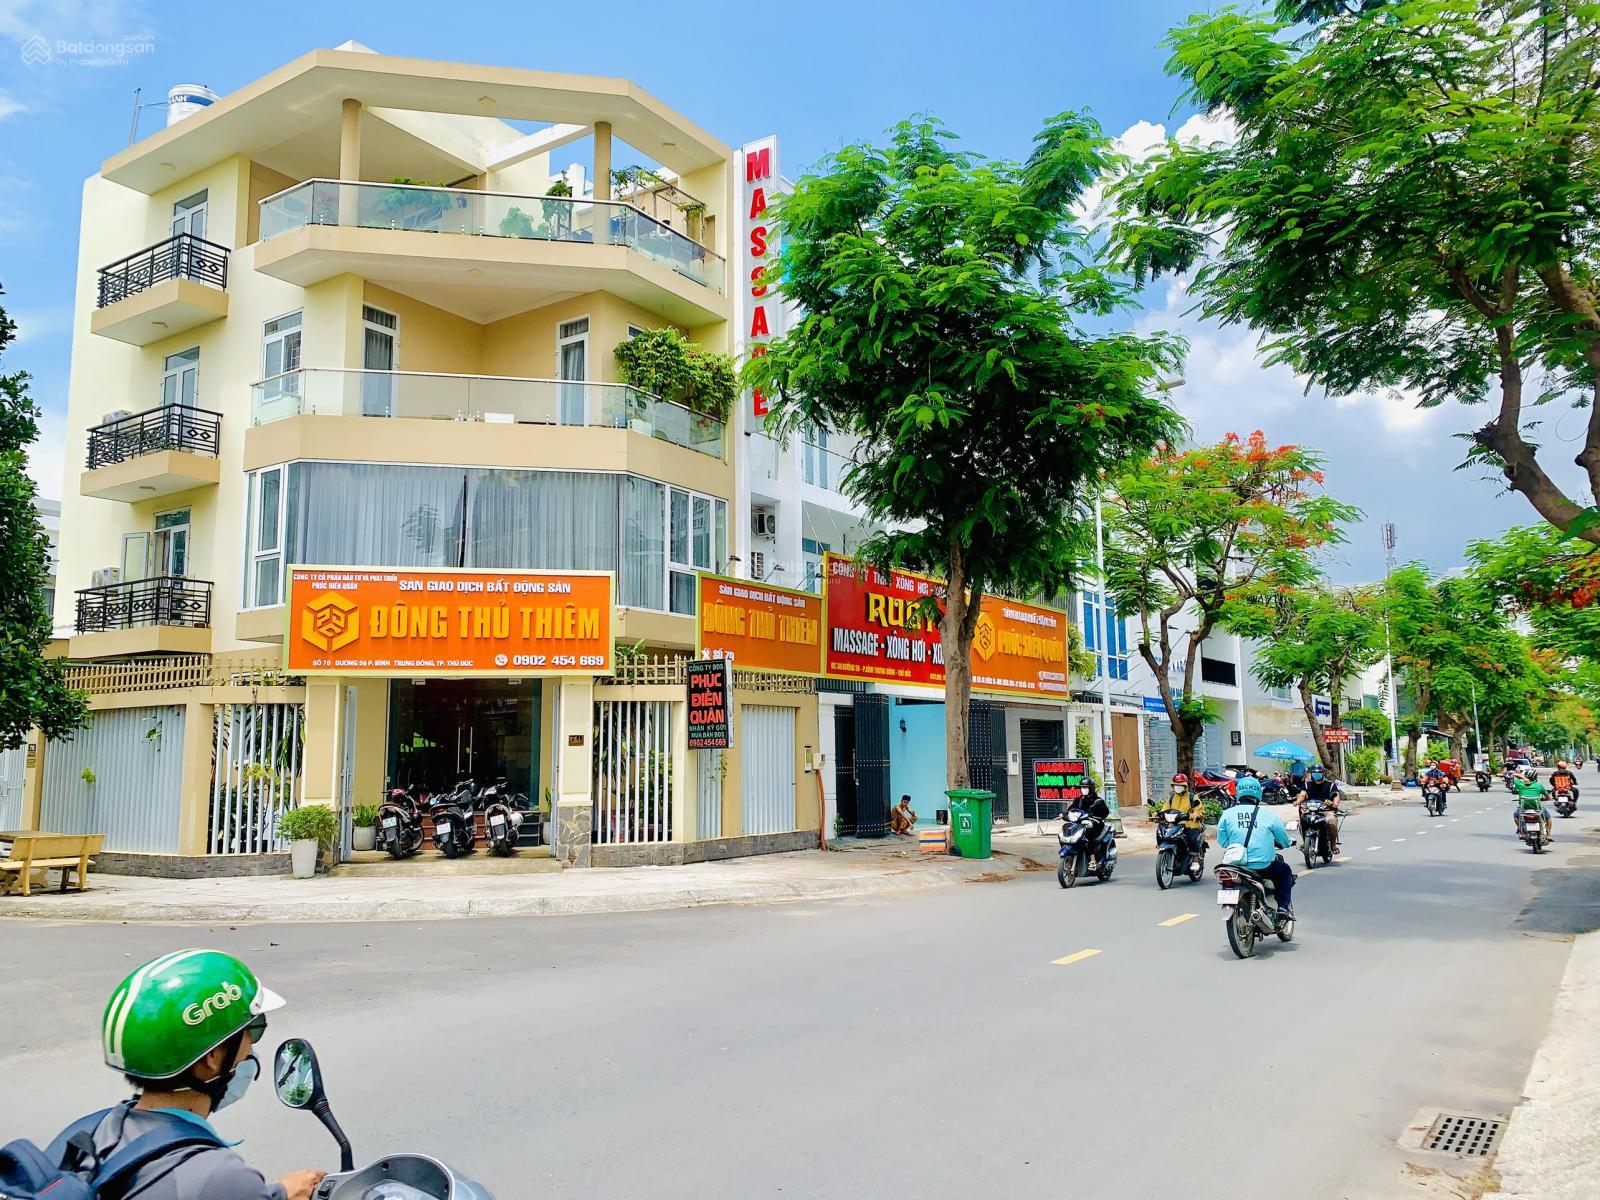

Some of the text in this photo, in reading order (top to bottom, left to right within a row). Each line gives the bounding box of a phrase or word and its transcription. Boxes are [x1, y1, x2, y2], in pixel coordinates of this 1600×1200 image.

[400, 578, 571, 596] SÀN GIAO DỊCH BẤT ĐỘNG SẢN
[718, 584, 732, 596] SÀN
[896, 575, 914, 592] XÔNG
[370, 599, 599, 640] ĐÔNG THỦ THIÊM
[702, 599, 818, 645] ĐÔNG THỦ THIÊM
[834, 628, 878, 656] MASSAGE
[886, 630, 910, 660] XÔNG
[912, 638, 926, 662] HƠI
[513, 655, 546, 666] 0902
[551, 656, 576, 666] 454
[688, 663, 704, 672] CÔNG
[691, 671, 722, 688] PHÚC
[691, 688, 722, 707] ĐIỀN
[690, 707, 724, 724] QUÂN
[1036, 762, 1084, 773] MASSAGE
[1036, 773, 1082, 786] XÔNG HƠ
[1040, 788, 1060, 799] XOA
[182, 980, 242, 1026] Grab
